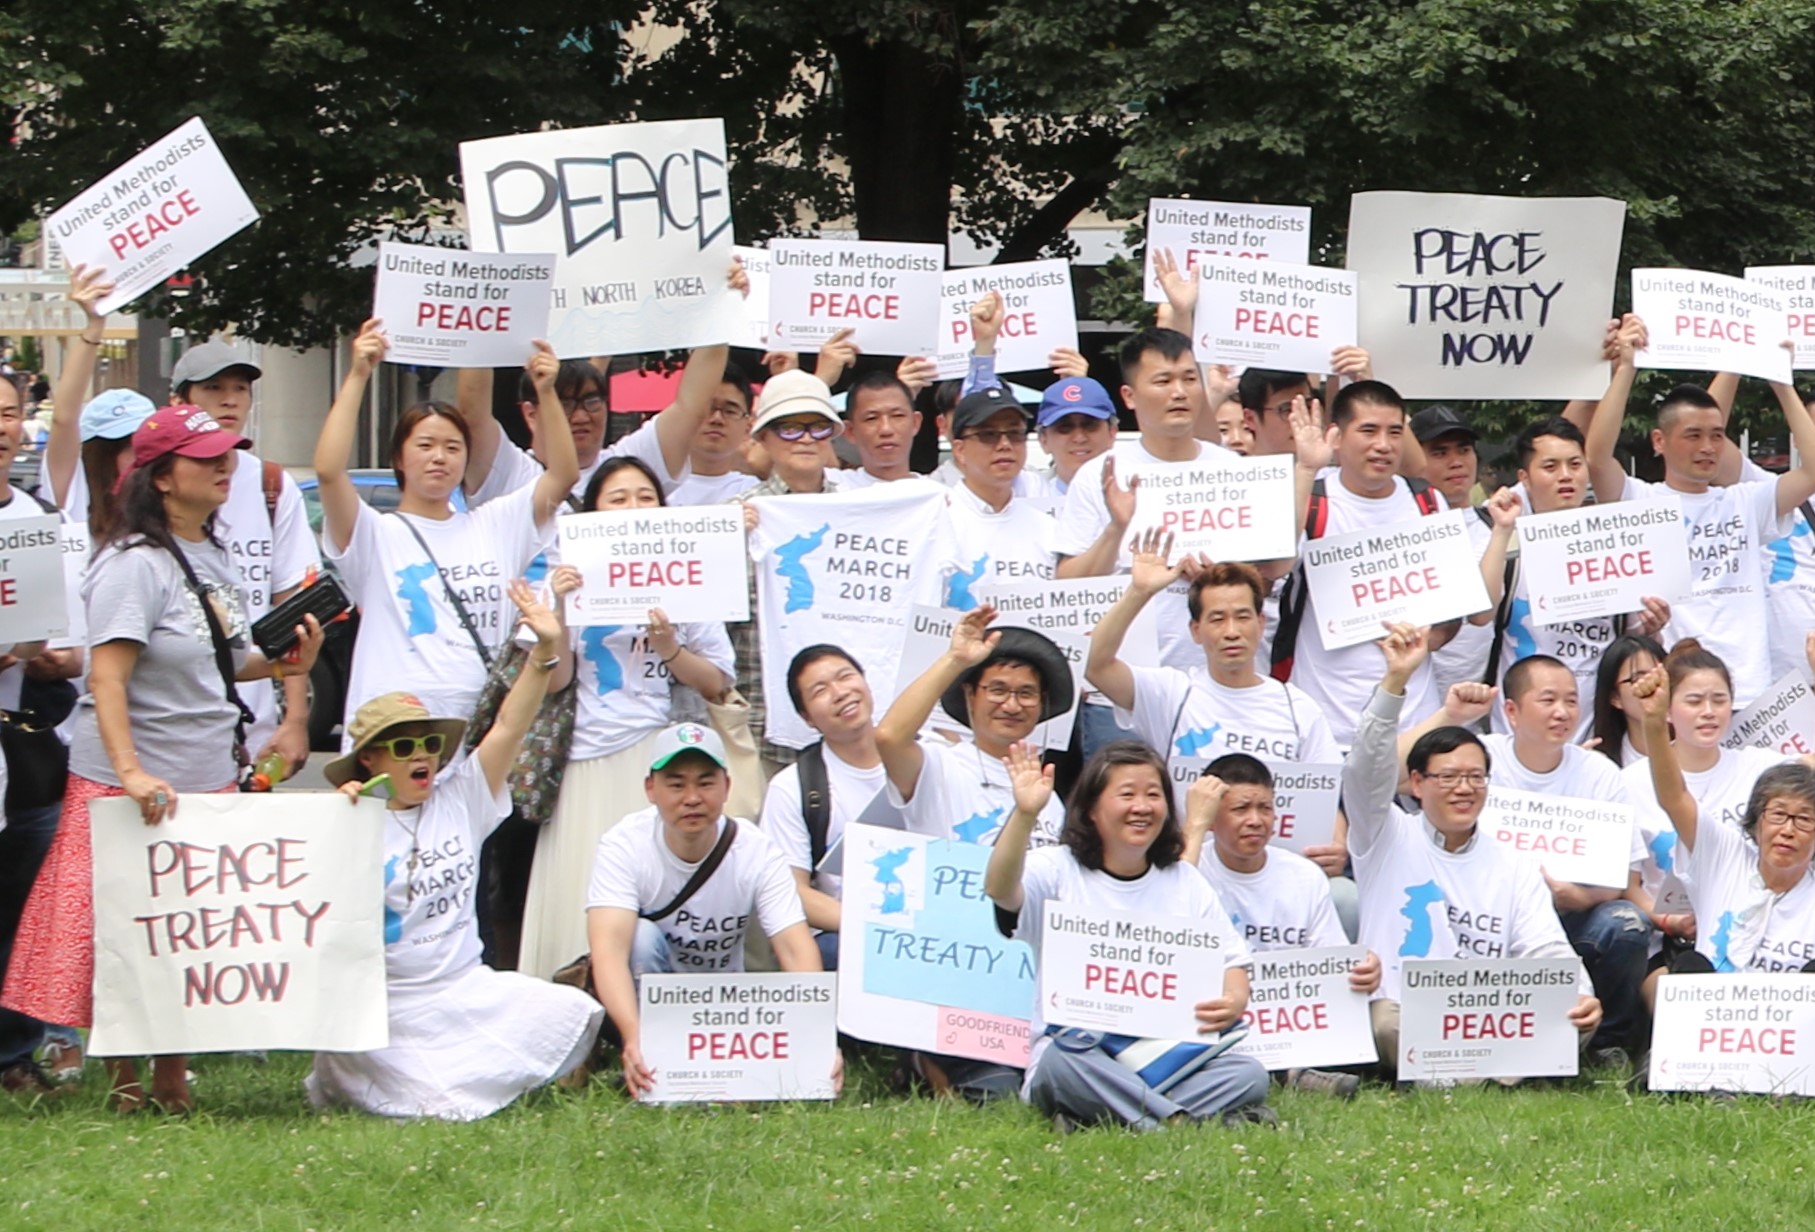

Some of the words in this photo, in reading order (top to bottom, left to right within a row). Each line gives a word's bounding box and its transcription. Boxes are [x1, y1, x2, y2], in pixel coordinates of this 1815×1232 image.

[58, 202, 114, 238] United
[112, 133, 206, 200] Methodists
[102, 197, 151, 232] stand
[151, 174, 178, 205] for
[485, 149, 732, 256] PEACE
[109, 189, 200, 261] PEACE
[1412, 228, 1545, 276] PEACE
[386, 254, 445, 275] United
[451, 258, 549, 281] Methodists
[424, 280, 478, 299] stand
[484, 282, 510, 299] for
[583, 282, 637, 307] NORTH
[655, 277, 706, 299] KOREA
[1393, 280, 1564, 327] TREATY
[417, 304, 511, 331] PEACE
[1439, 332, 1534, 368] NOW
[1063, 385, 1081, 402] C
[565, 521, 628, 541] United
[634, 517, 738, 536] Methodists
[1524, 521, 1581, 542] United
[1586, 507, 1679, 534] Methodists
[1692, 515, 1744, 540] PEACE
[611, 538, 664, 556] stand
[670, 538, 697, 555] for
[835, 533, 908, 556] PEACE
[1567, 536, 1616, 556] stand
[1620, 530, 1644, 548] for
[1689, 536, 1748, 561] MARCH
[609, 560, 703, 588] PEACE
[826, 557, 911, 580] MARCH
[995, 561, 1053, 579] PEACE
[1566, 551, 1653, 585] PEACE
[1701, 558, 1739, 581] 2018
[839, 582, 892, 602] 2018
[820, 611, 882, 626] WASHINGTON
[1544, 621, 1610, 641] MARCH
[1556, 641, 1600, 659] 2018
[1225, 732, 1294, 761] PEACE
[147, 838, 310, 897] PEACE
[134, 901, 331, 957] TREATY
[675, 910, 749, 933] PEACE
[1245, 924, 1307, 945] PEACE
[676, 951, 731, 969] 2018
[873, 928, 1004, 974] TREATY
[184, 962, 290, 1008] NOW
[1407, 969, 1468, 988] United
[1473, 968, 1574, 988] Methodists
[648, 985, 714, 1004] United
[719, 984, 830, 1004] Methodists
[1447, 990, 1500, 1007] stand
[1505, 990, 1532, 1007] for
[692, 1007, 749, 1027] stand
[756, 1007, 785, 1026] for
[1442, 1012, 1535, 1040] PEACE
[688, 1031, 789, 1060] PEACE
[979, 1034, 1006, 1051] USA
[1422, 1048, 1451, 1059] CHURCH
[1461, 1048, 1492, 1058] SOCIETY
[666, 1070, 698, 1080] CHURCH
[709, 1070, 743, 1080] SOCIETY
